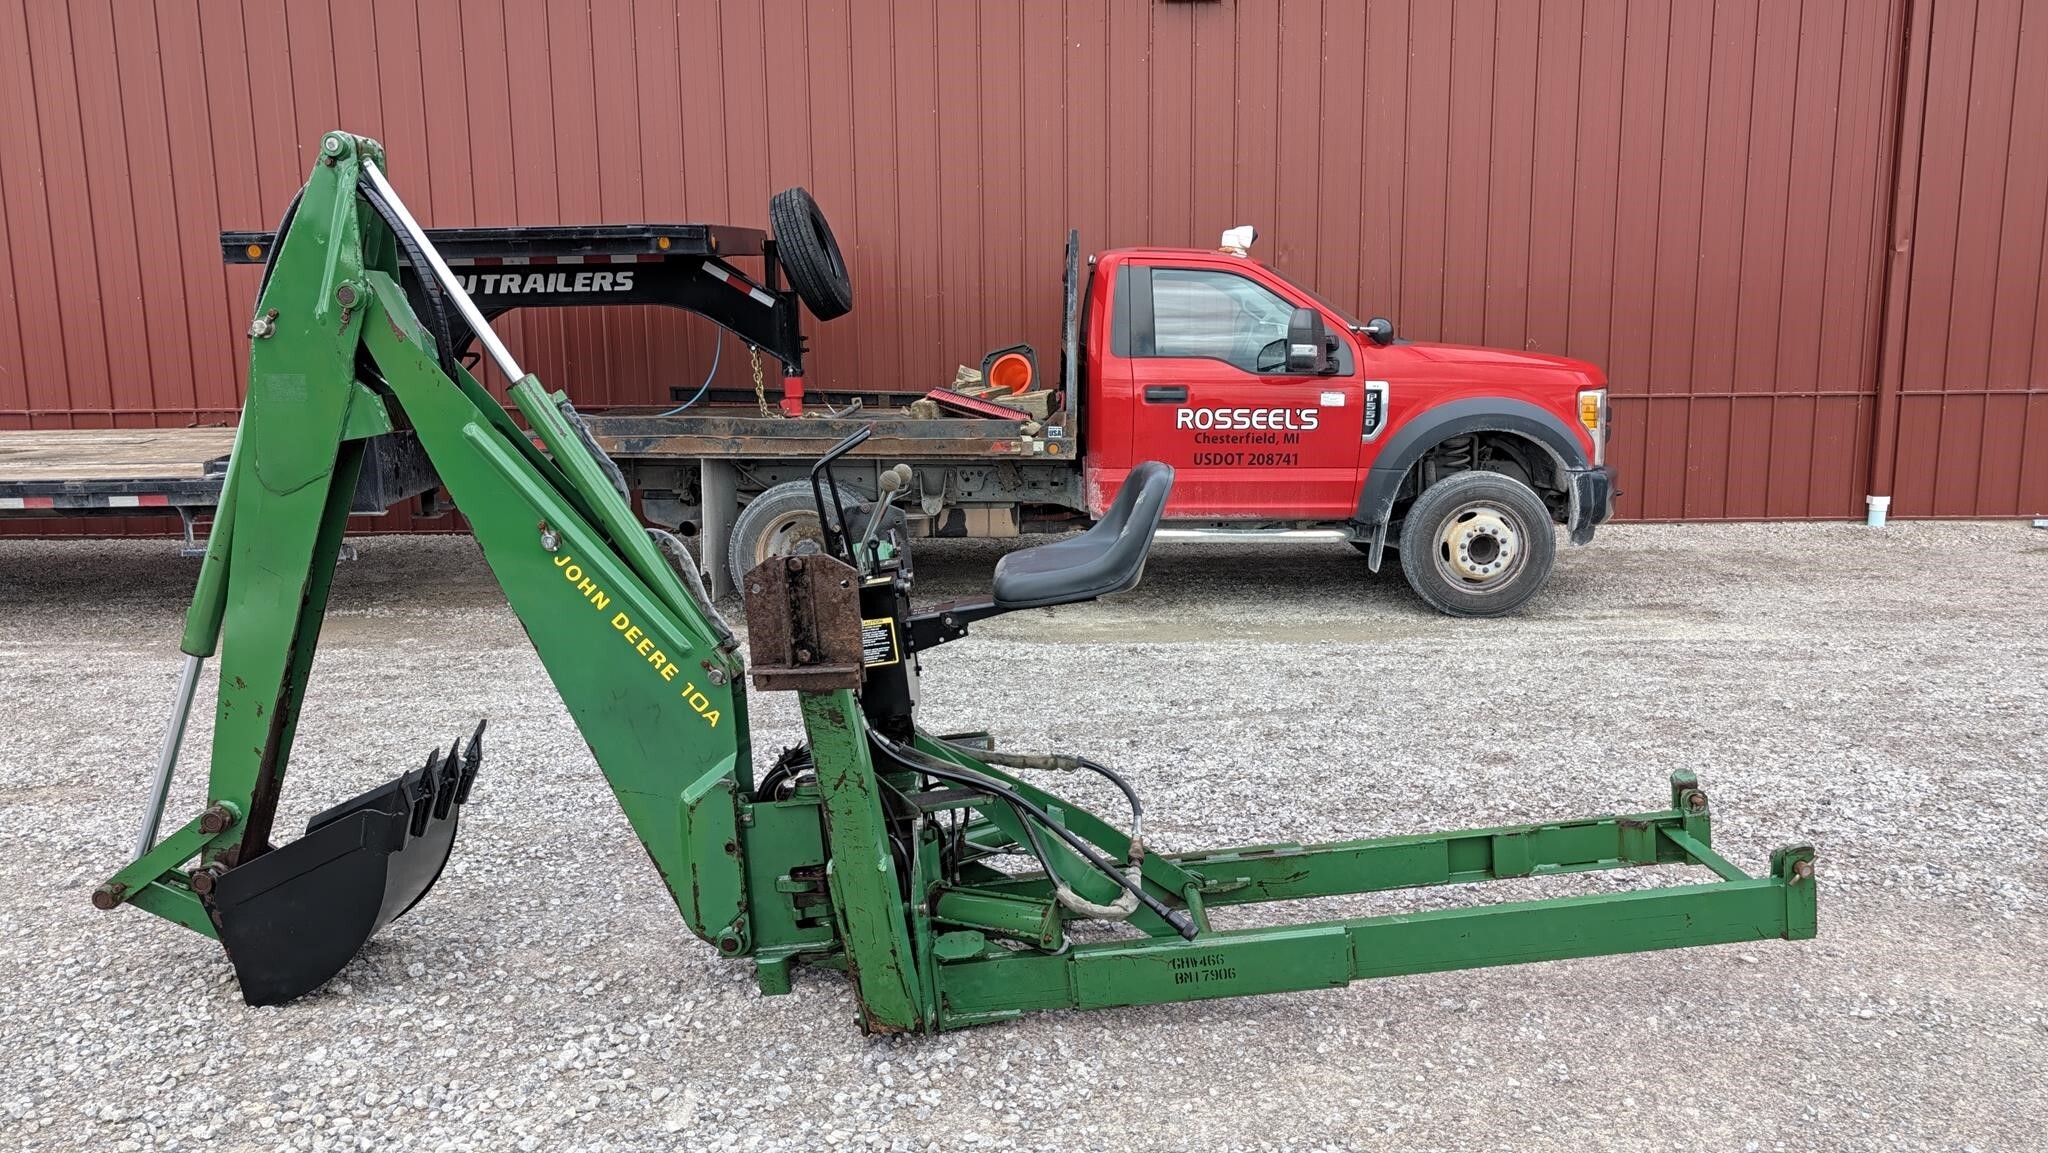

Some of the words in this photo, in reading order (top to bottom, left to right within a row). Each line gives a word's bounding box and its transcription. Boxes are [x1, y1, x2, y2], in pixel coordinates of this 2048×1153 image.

[481, 271, 634, 294] TRAILERS
[1176, 407, 1319, 430] ROSSEEL'S
[1194, 432, 1280, 446] Chesterfield,
[1283, 433, 1299, 444] MI
[1193, 452, 1244, 466] USDOT
[1247, 452, 1299, 466] 208741
[554, 556, 610, 610] JOHN
[611, 612, 679, 681] DEERE
[681, 682, 720, 727] 10A
